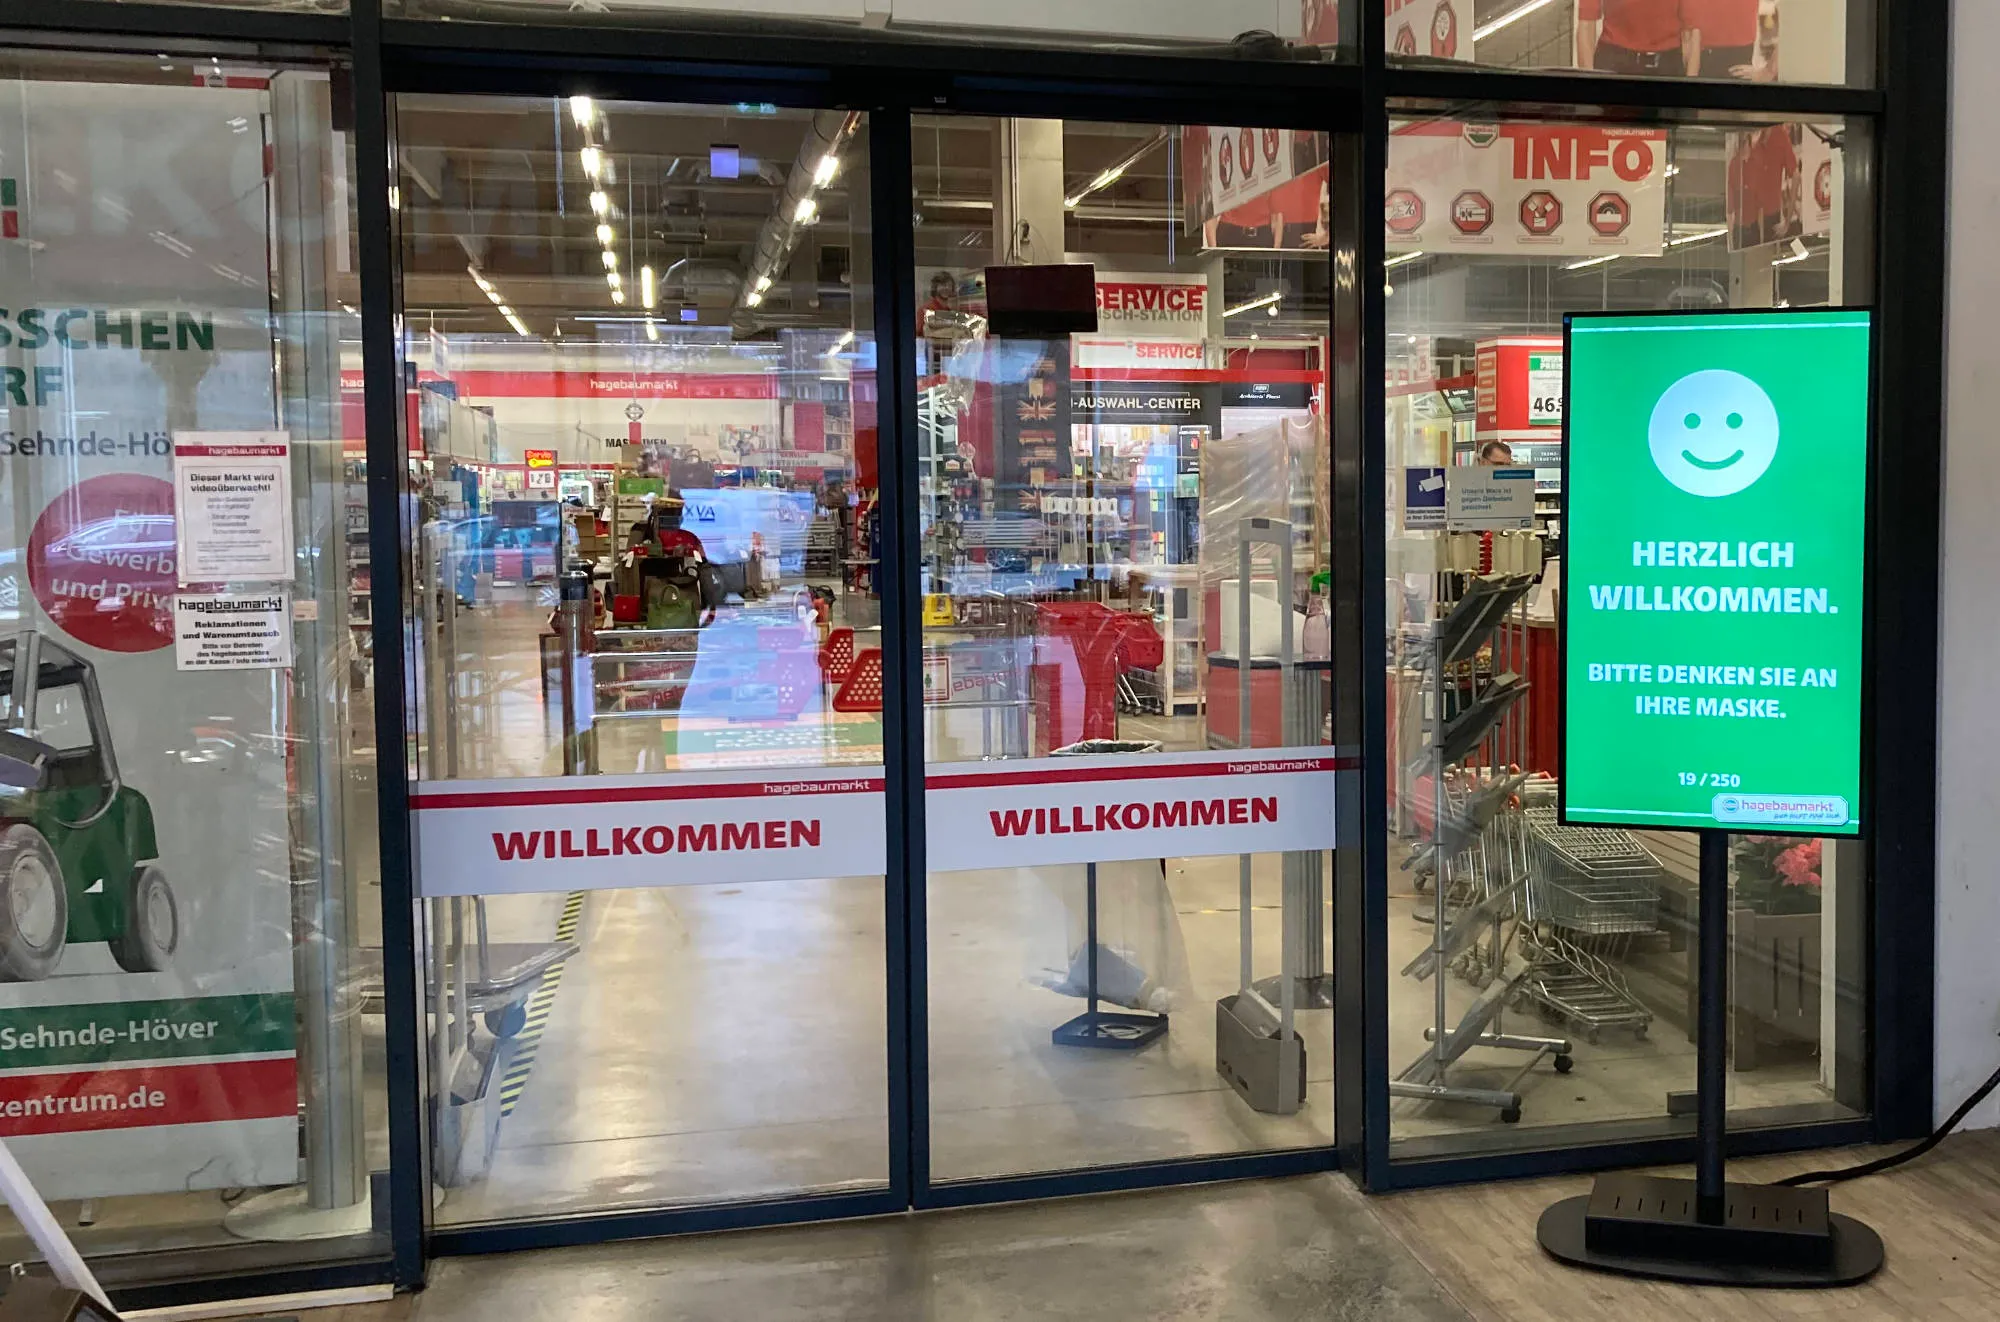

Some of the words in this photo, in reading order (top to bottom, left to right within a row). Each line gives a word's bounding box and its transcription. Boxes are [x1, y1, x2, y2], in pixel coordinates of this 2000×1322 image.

[1512, 137, 1654, 182] INFO
[590, 379, 678, 391] hagebaumarkt
[208, 446, 280, 456] hagebaumarkt
[190, 474, 221, 482] Dieser
[224, 474, 251, 482] Markt
[254, 473, 275, 482] wird
[190, 484, 271, 492] videoüberwacht!
[67, 541, 178, 575] Gewerb
[1632, 541, 1794, 568] HERZLICH
[51, 578, 108, 601] und
[1588, 585, 1839, 614] WILLKOMMEN.
[178, 596, 282, 613] hagebaumarkt
[203, 630, 280, 639] Warenumtausch
[1588, 663, 1653, 683] BITTE
[1657, 664, 1755, 685] DENKEN
[1759, 667, 1796, 687] SIE
[1800, 668, 1838, 687] AN
[1635, 695, 1691, 715] IHRE
[1695, 697, 1787, 718] MASKE.
[1227, 758, 1320, 774] hagebaumarkt
[763, 780, 870, 796] hagebaumarkt
[1678, 772, 1696, 786] 19
[1699, 773, 1708, 787] /
[1710, 774, 1741, 788] 250
[1741, 800, 1834, 812] hagebaumarkt
[989, 796, 1278, 837] WILLKOMMEN
[491, 819, 821, 861] WILLKOMMEN
[0, 1018, 219, 1050] Sehnde-Höver
